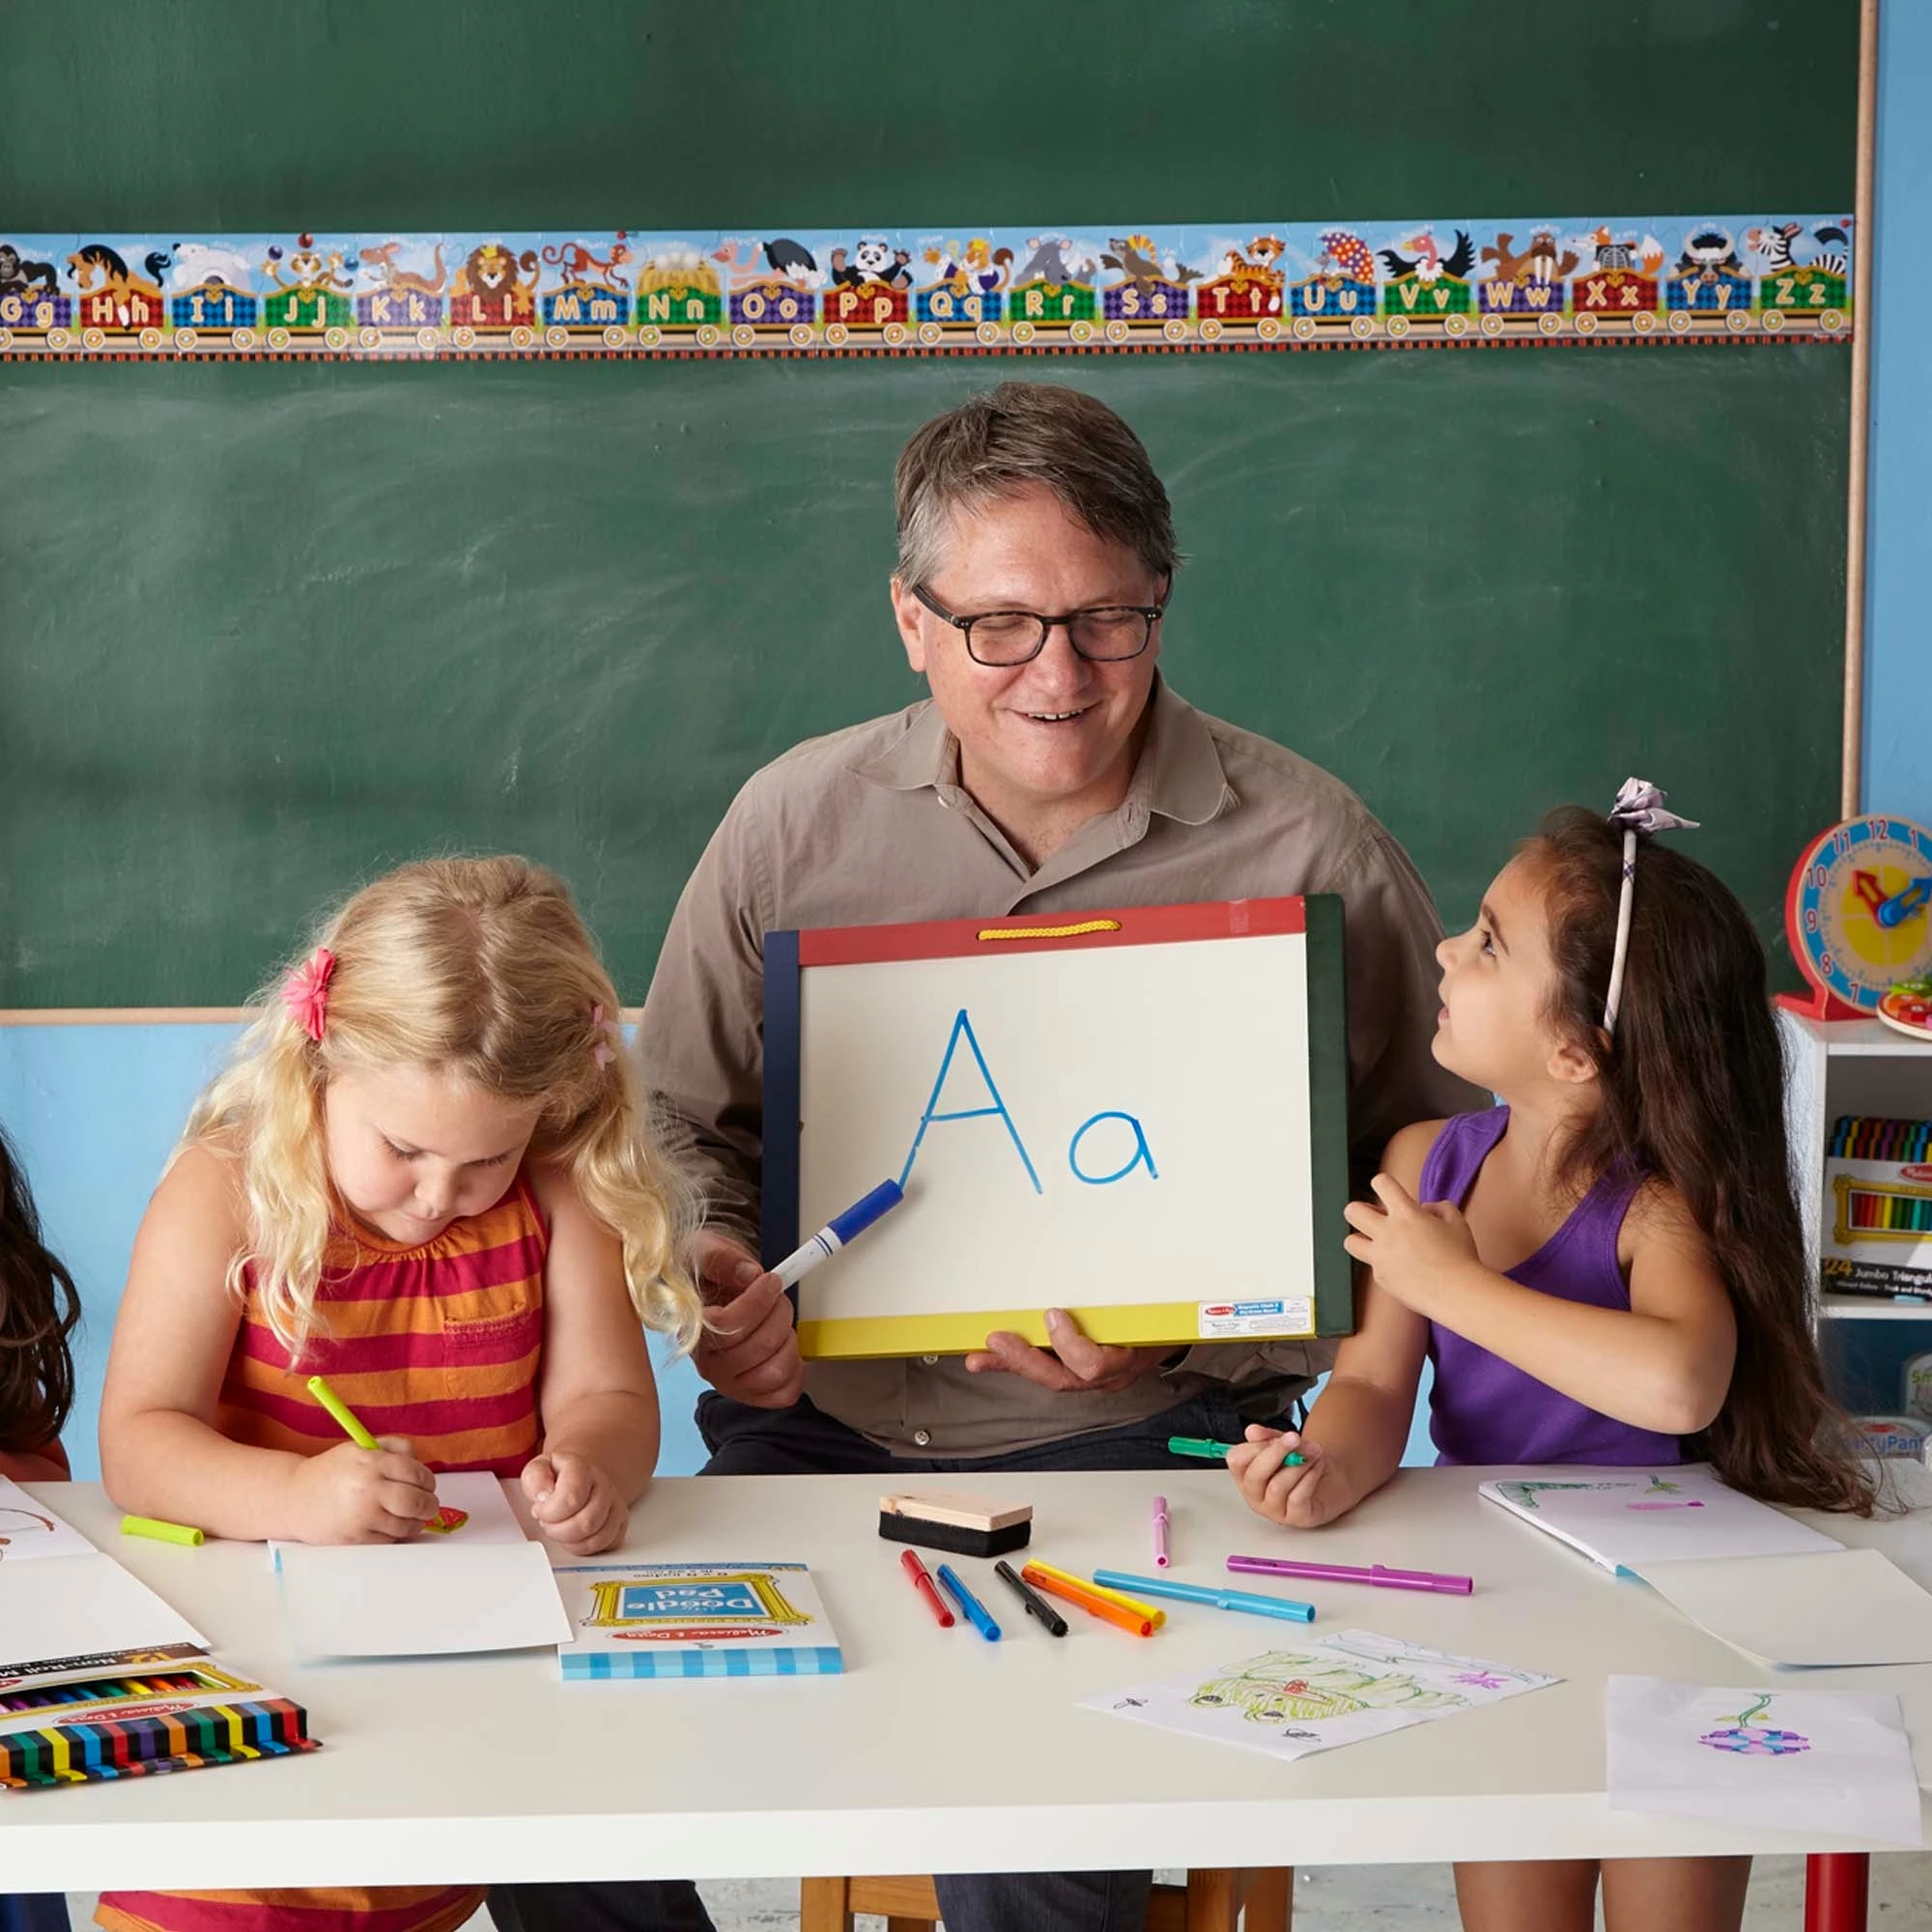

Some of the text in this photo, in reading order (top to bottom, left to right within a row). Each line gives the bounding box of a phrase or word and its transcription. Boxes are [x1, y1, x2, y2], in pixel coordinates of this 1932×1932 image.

[1868, 819, 1888, 840] 12
[1911, 828, 1918, 849] 1
[1833, 833, 1851, 852] 11
[1806, 866, 1828, 889] 10
[1806, 909, 1817, 932] 9
[1821, 952, 1833, 976] 8
[1850, 982, 1859, 1004] 7
[1824, 1257, 1853, 1275] 24
[1855, 1267, 1889, 1281] Jumbo
[627, 1598, 753, 1611] Doodle
[656, 1588, 725, 1600] Pad
[123, 1651, 171, 1664] 12
